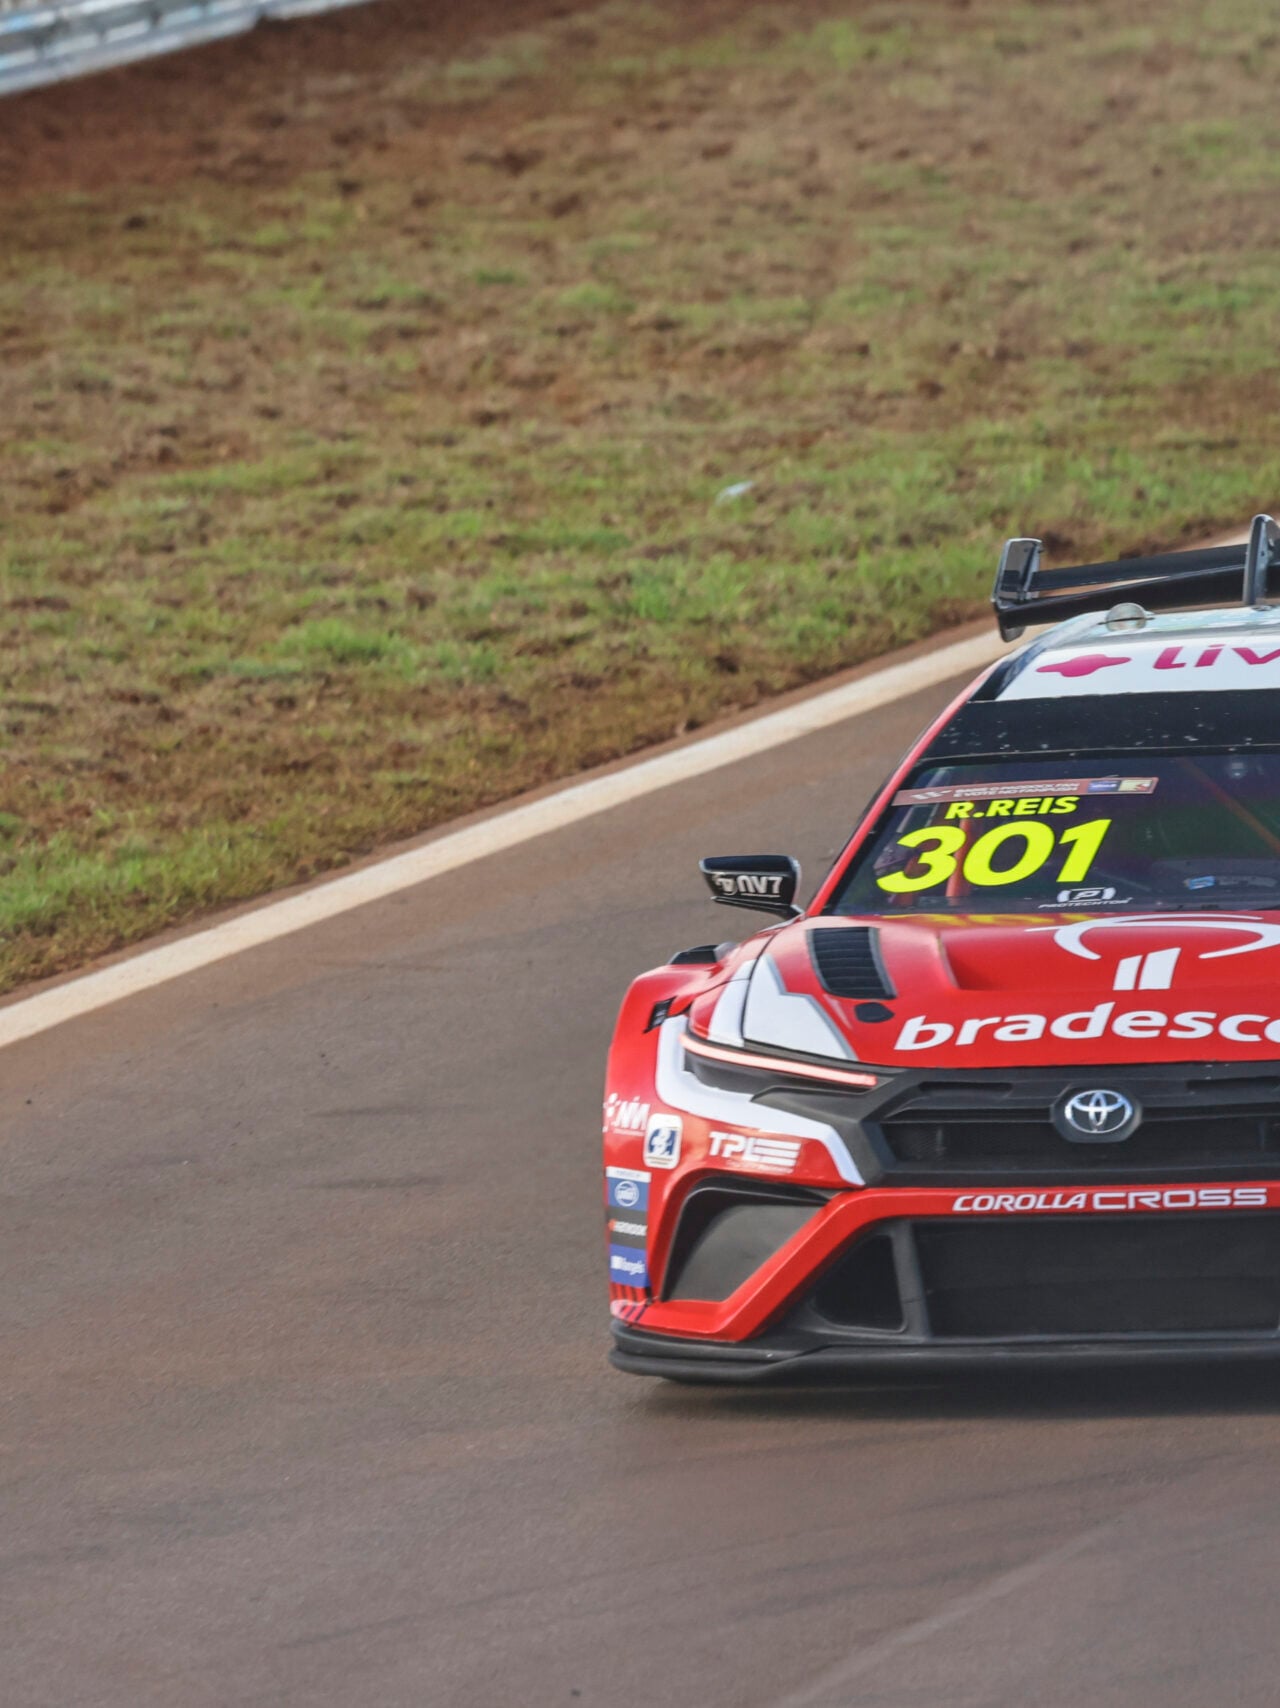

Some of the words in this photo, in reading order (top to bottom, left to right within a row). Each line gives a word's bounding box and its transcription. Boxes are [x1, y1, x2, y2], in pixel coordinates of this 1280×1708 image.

[945, 796, 1080, 819] R.REIS
[879, 819, 1112, 893] 301
[953, 1192, 1087, 1212] COROLLA
[1092, 1188, 1268, 1210] CROSS
